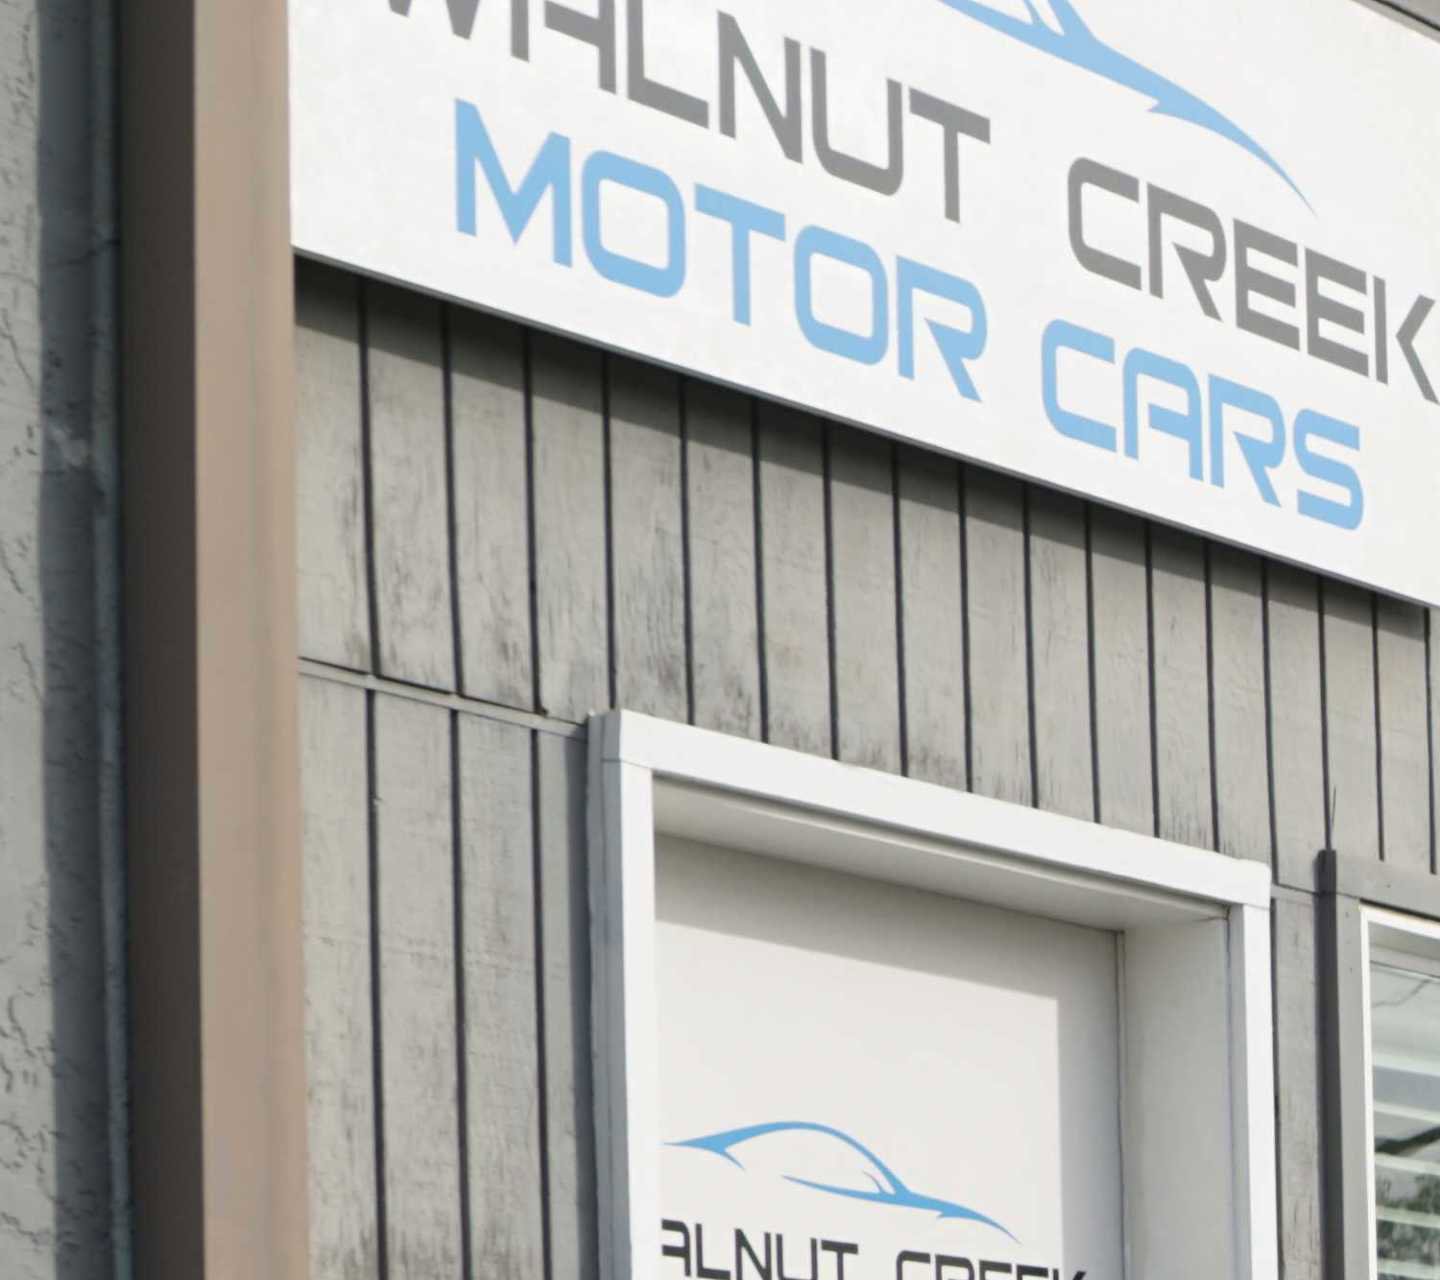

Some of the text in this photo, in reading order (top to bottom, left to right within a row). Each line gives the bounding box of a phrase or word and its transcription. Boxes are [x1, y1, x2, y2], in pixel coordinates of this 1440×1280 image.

[455, 98, 1364, 531] MOTOR CARS
[1067, 157, 1440, 405] CREEK
